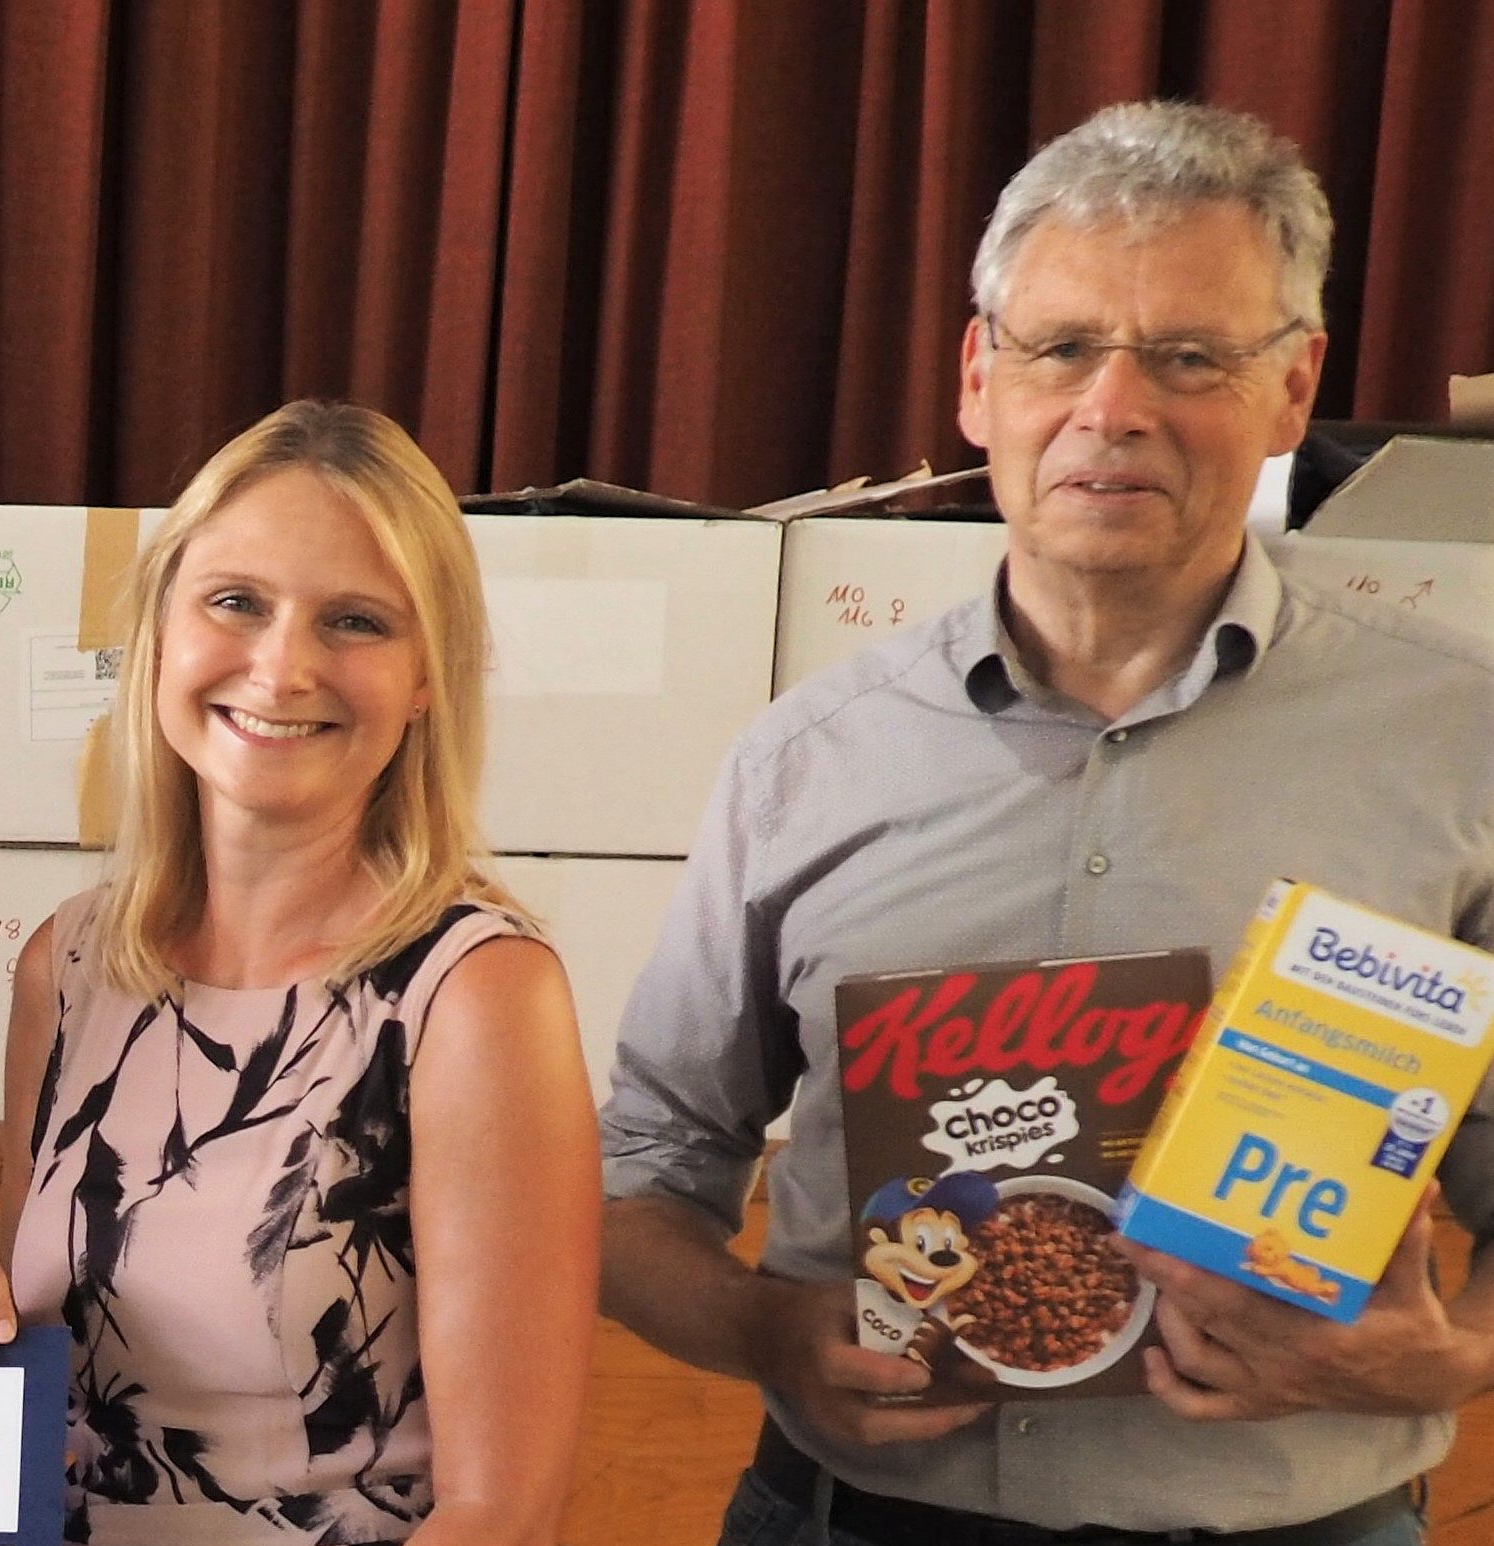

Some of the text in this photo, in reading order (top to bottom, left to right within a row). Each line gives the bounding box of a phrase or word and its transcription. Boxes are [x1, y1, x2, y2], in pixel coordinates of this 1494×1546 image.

[1309, 926, 1466, 1014] Bebivita
[1254, 999, 1423, 1076] Anfangsmilch
[944, 1095, 1061, 1140] choco
[965, 1121, 1056, 1158] krispies
[1212, 1131, 1349, 1239] Pre
